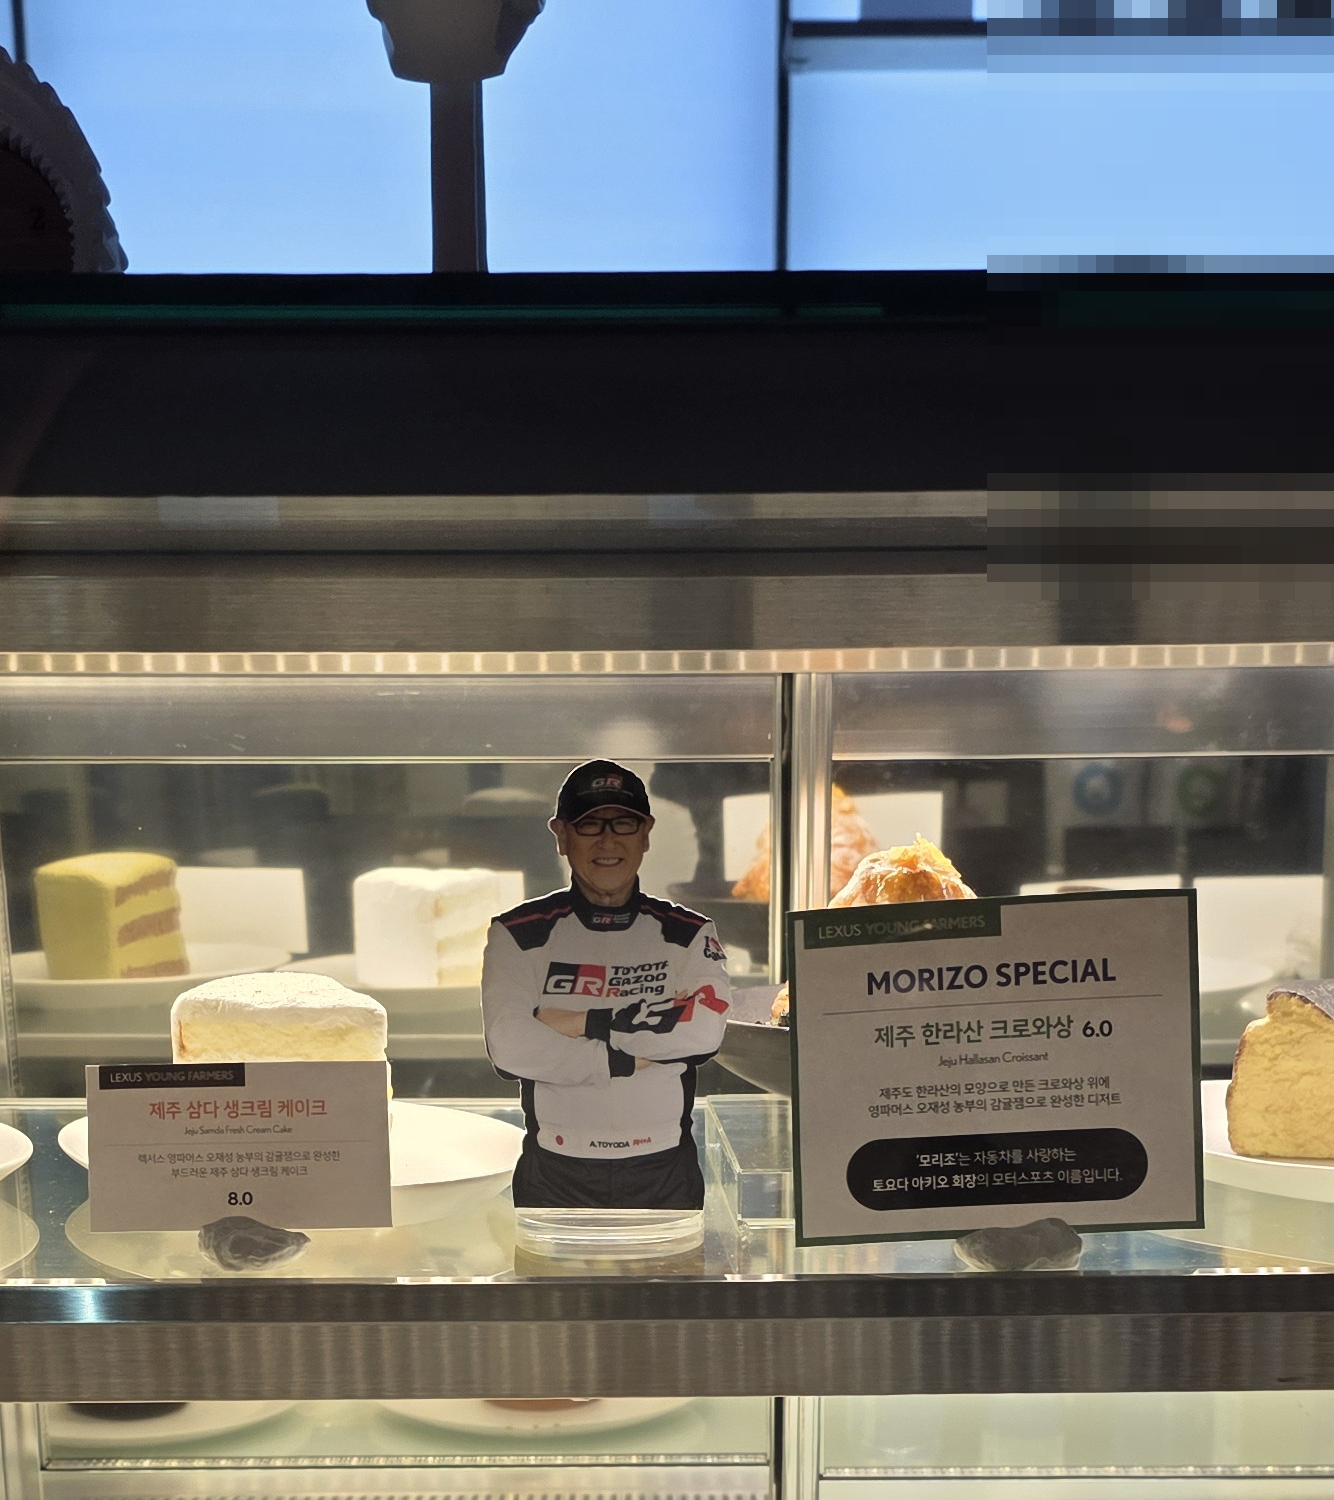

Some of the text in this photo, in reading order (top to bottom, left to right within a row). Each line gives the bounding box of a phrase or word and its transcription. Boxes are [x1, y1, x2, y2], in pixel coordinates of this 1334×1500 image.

[818, 923, 862, 940] LEXUS
[544, 971, 605, 996] GR
[608, 972, 667, 987] GAZOO
[867, 957, 1117, 996] MORIZO SPECIAL
[605, 984, 665, 998] Racing
[874, 1014, 1113, 1049] 제주 한라산 크로와상 6.0
[937, 1051, 1049, 1069] Jeju Hallasan Croissant
[109, 1070, 234, 1083] LEXUS YOUNG FARMERS
[878, 1075, 1110, 1101] 제주도 한라산의 모양으로 만든 크로와상 위에
[148, 1098, 328, 1121] 제주 삼다 생크림 케이크
[867, 1092, 1122, 1119] 영파머스 오재성 농부의 감귤잼으로 완성한 디저트
[916, 1147, 1077, 1168] '모리조'는 자동차를 사랑하는
[871, 1167, 1123, 1192] 토요다 아키오 회장의 모터스포츠 이름입니다.
[227, 1191, 254, 1206] 8.0
